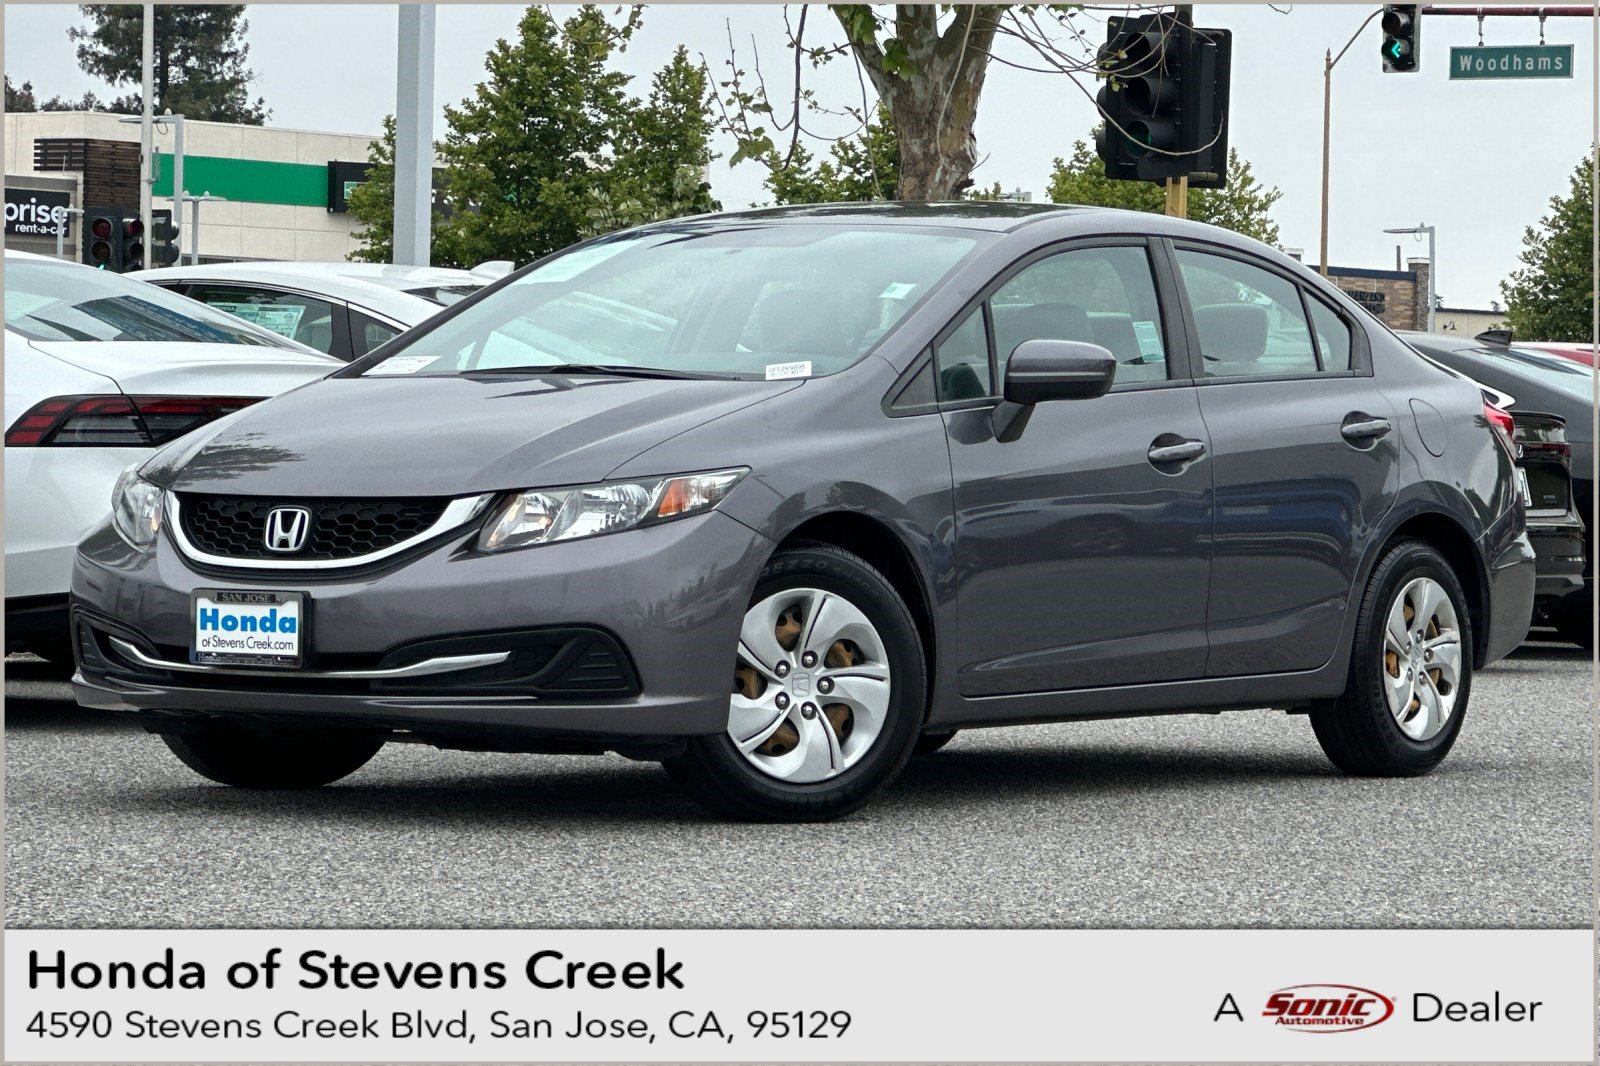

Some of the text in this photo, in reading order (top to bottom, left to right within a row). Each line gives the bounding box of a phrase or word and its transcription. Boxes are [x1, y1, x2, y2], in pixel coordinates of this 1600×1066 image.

[1459, 54, 1563, 71] Woodhams
[15, 223, 67, 235] rent-a-cr
[222, 592, 272, 603] SAN JOSE
[200, 608, 296, 633] Honda
[202, 635, 294, 650] of Stevens Creek.com
